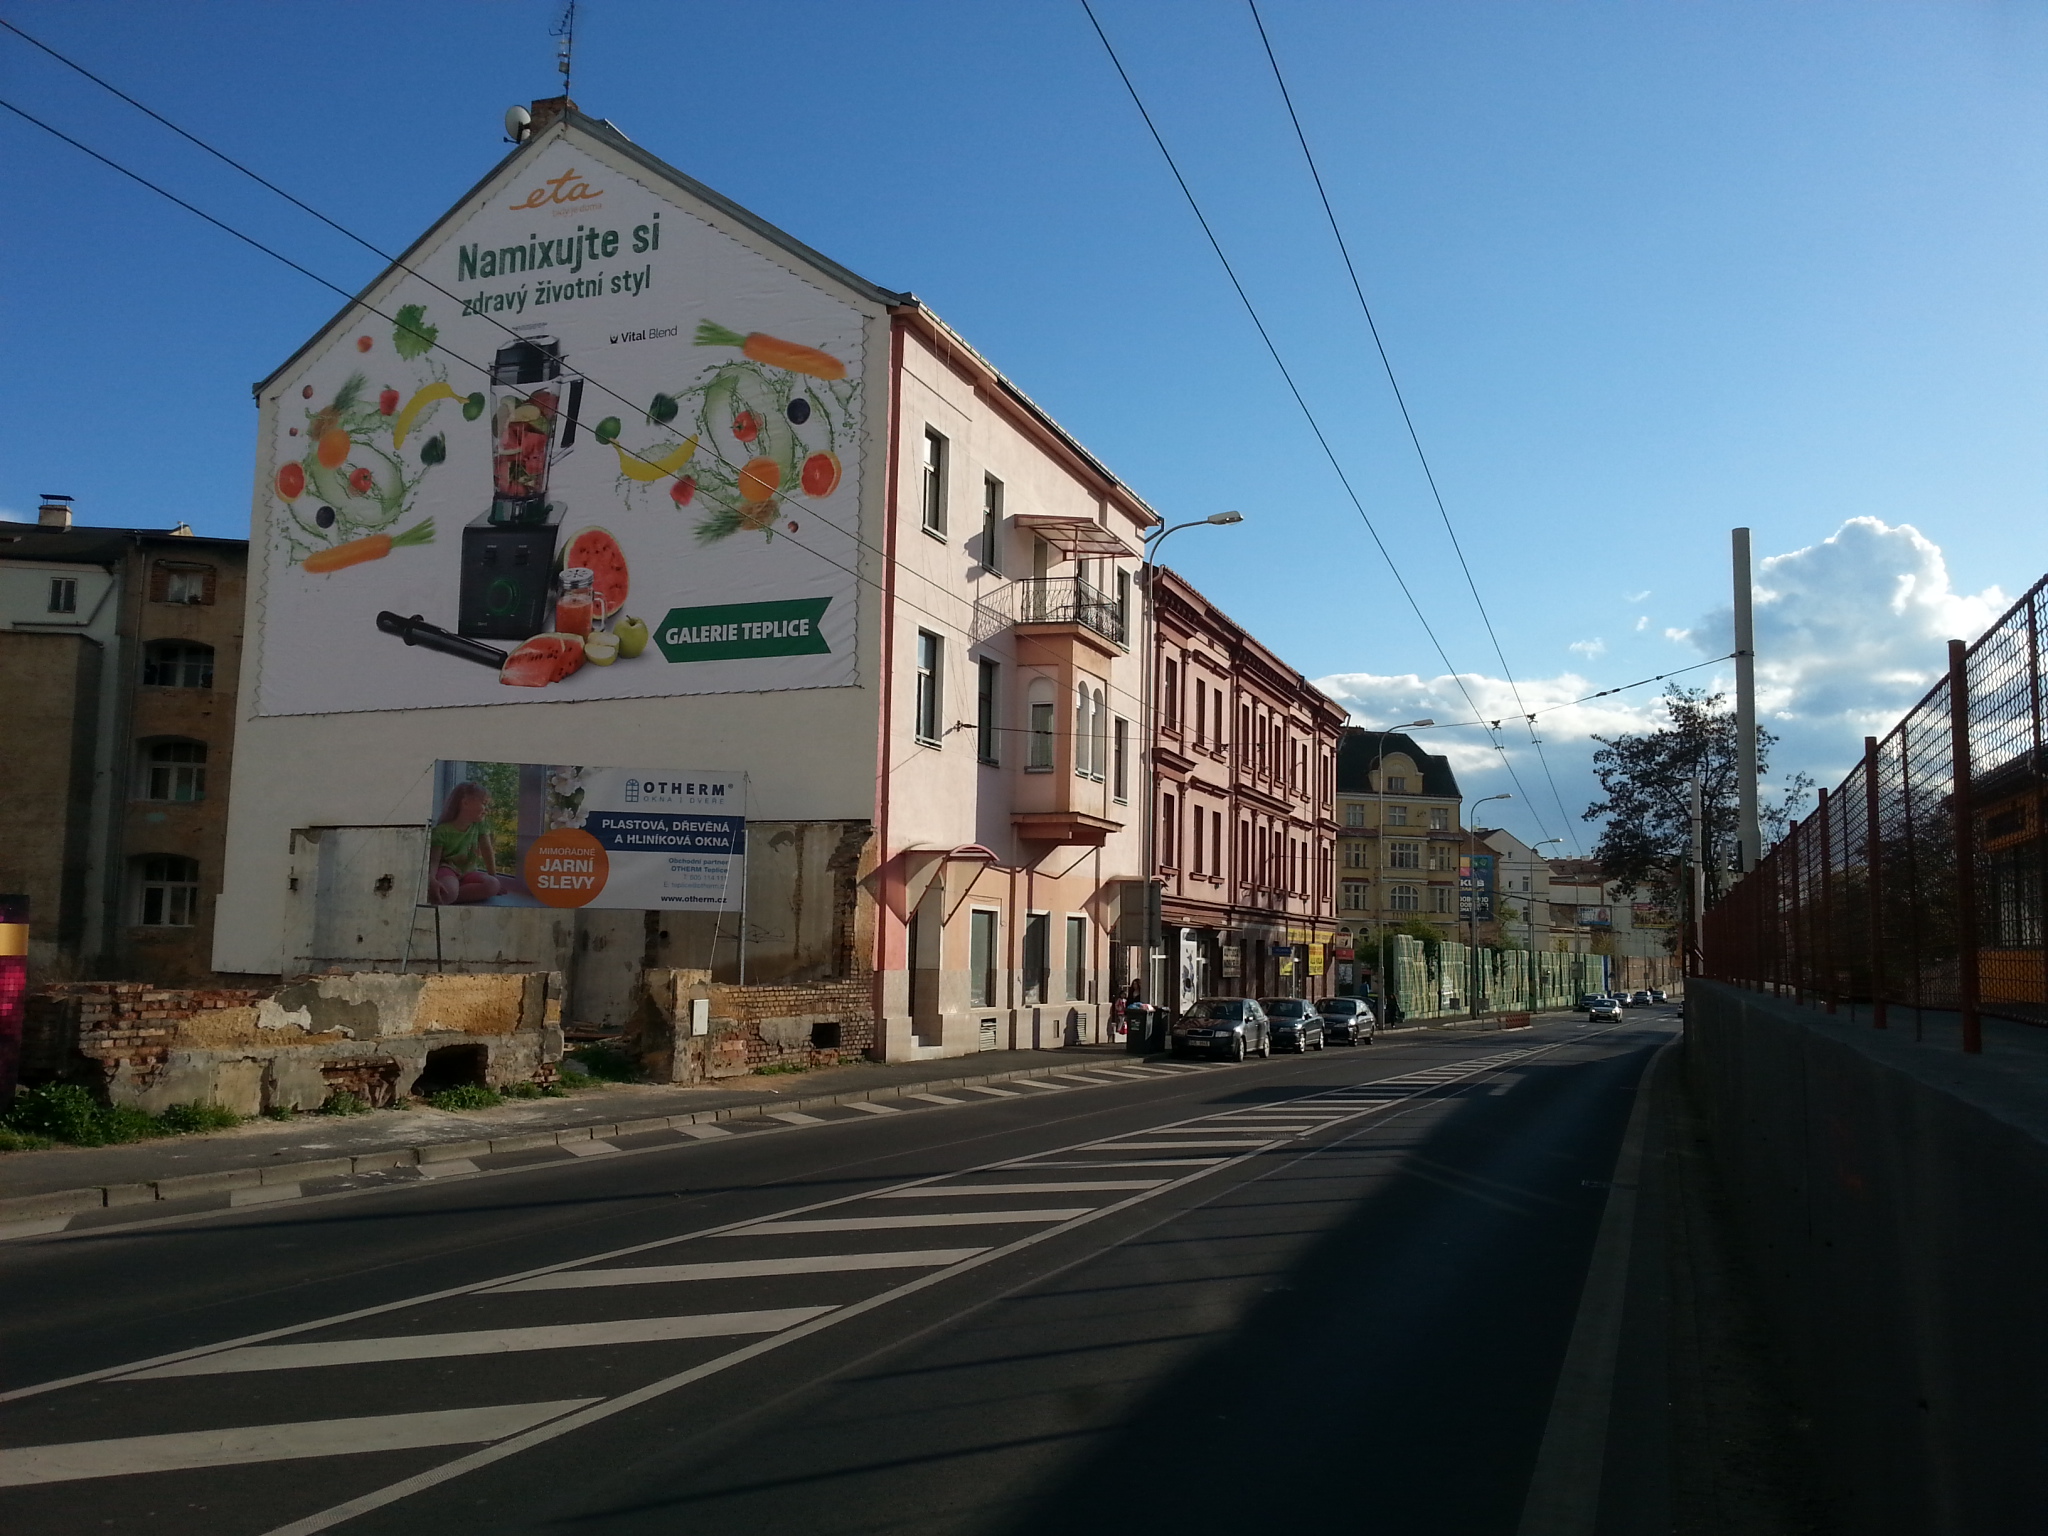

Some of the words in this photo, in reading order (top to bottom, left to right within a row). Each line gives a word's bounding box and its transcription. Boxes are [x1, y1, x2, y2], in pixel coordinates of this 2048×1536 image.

[509, 168, 604, 210] eta
[458, 225, 619, 282] Namixujte
[632, 212, 660, 254] si
[462, 283, 528, 316] zdravý
[535, 272, 604, 306] životní
[610, 264, 651, 297] styl
[621, 330, 646, 342] Vital
[648, 325, 678, 340] Blend
[666, 624, 738, 645] GALERIE
[742, 618, 810, 640] TEPLICE
[602, 818, 669, 832] PLASTOVÁ,
[672, 820, 730, 832] DŘEVĚNÁ
[614, 834, 624, 844] A
[626, 834, 692, 846] HLINÍKOVÁ
[694, 836, 730, 846] OKNA
[540, 858, 594, 872] JARNÍ
[537, 875, 595, 890] SLEVY
[661, 896, 728, 904] www.otherm.cz
